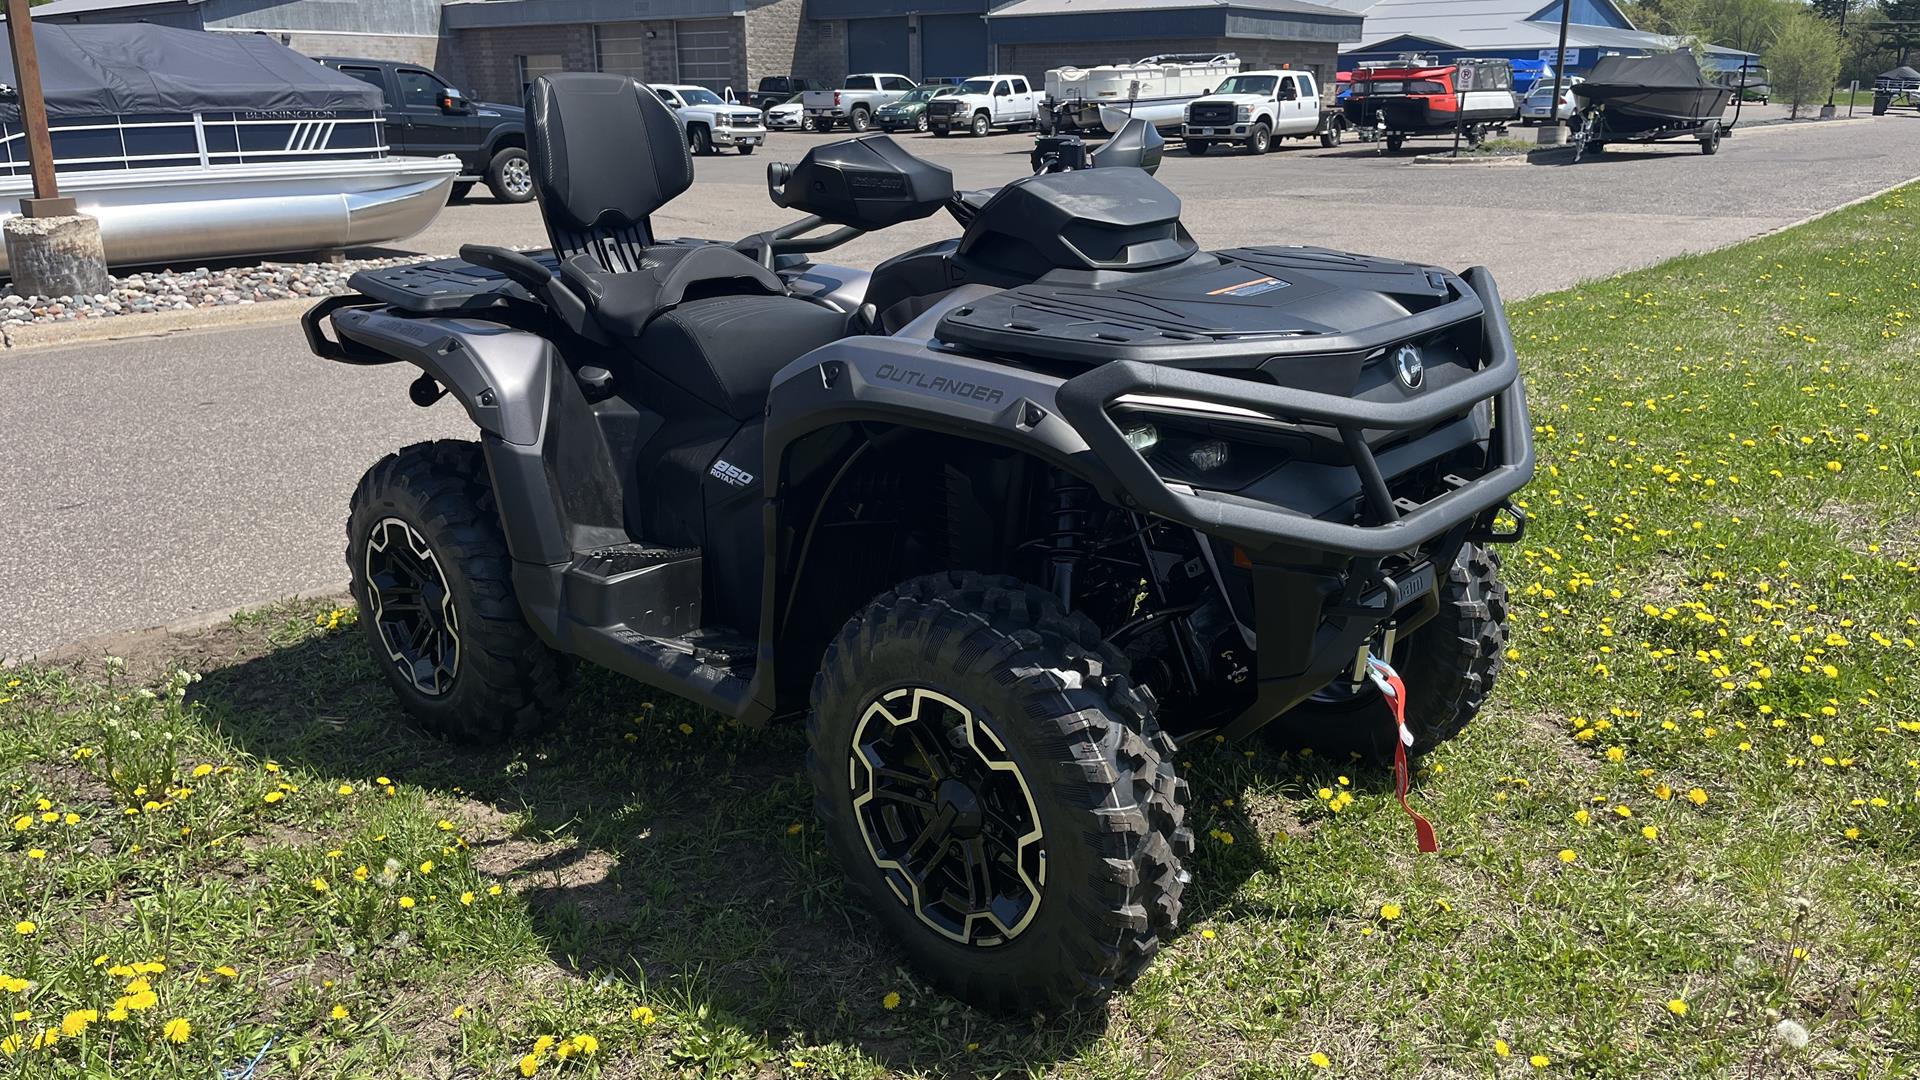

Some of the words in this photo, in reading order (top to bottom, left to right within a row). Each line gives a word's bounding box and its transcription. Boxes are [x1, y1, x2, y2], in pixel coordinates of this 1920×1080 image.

[245, 110, 336, 120] BENNINGTON
[875, 363, 1004, 404] OUTLANDER
[710, 467, 735, 485] ROTAX
[713, 459, 754, 484] 850
